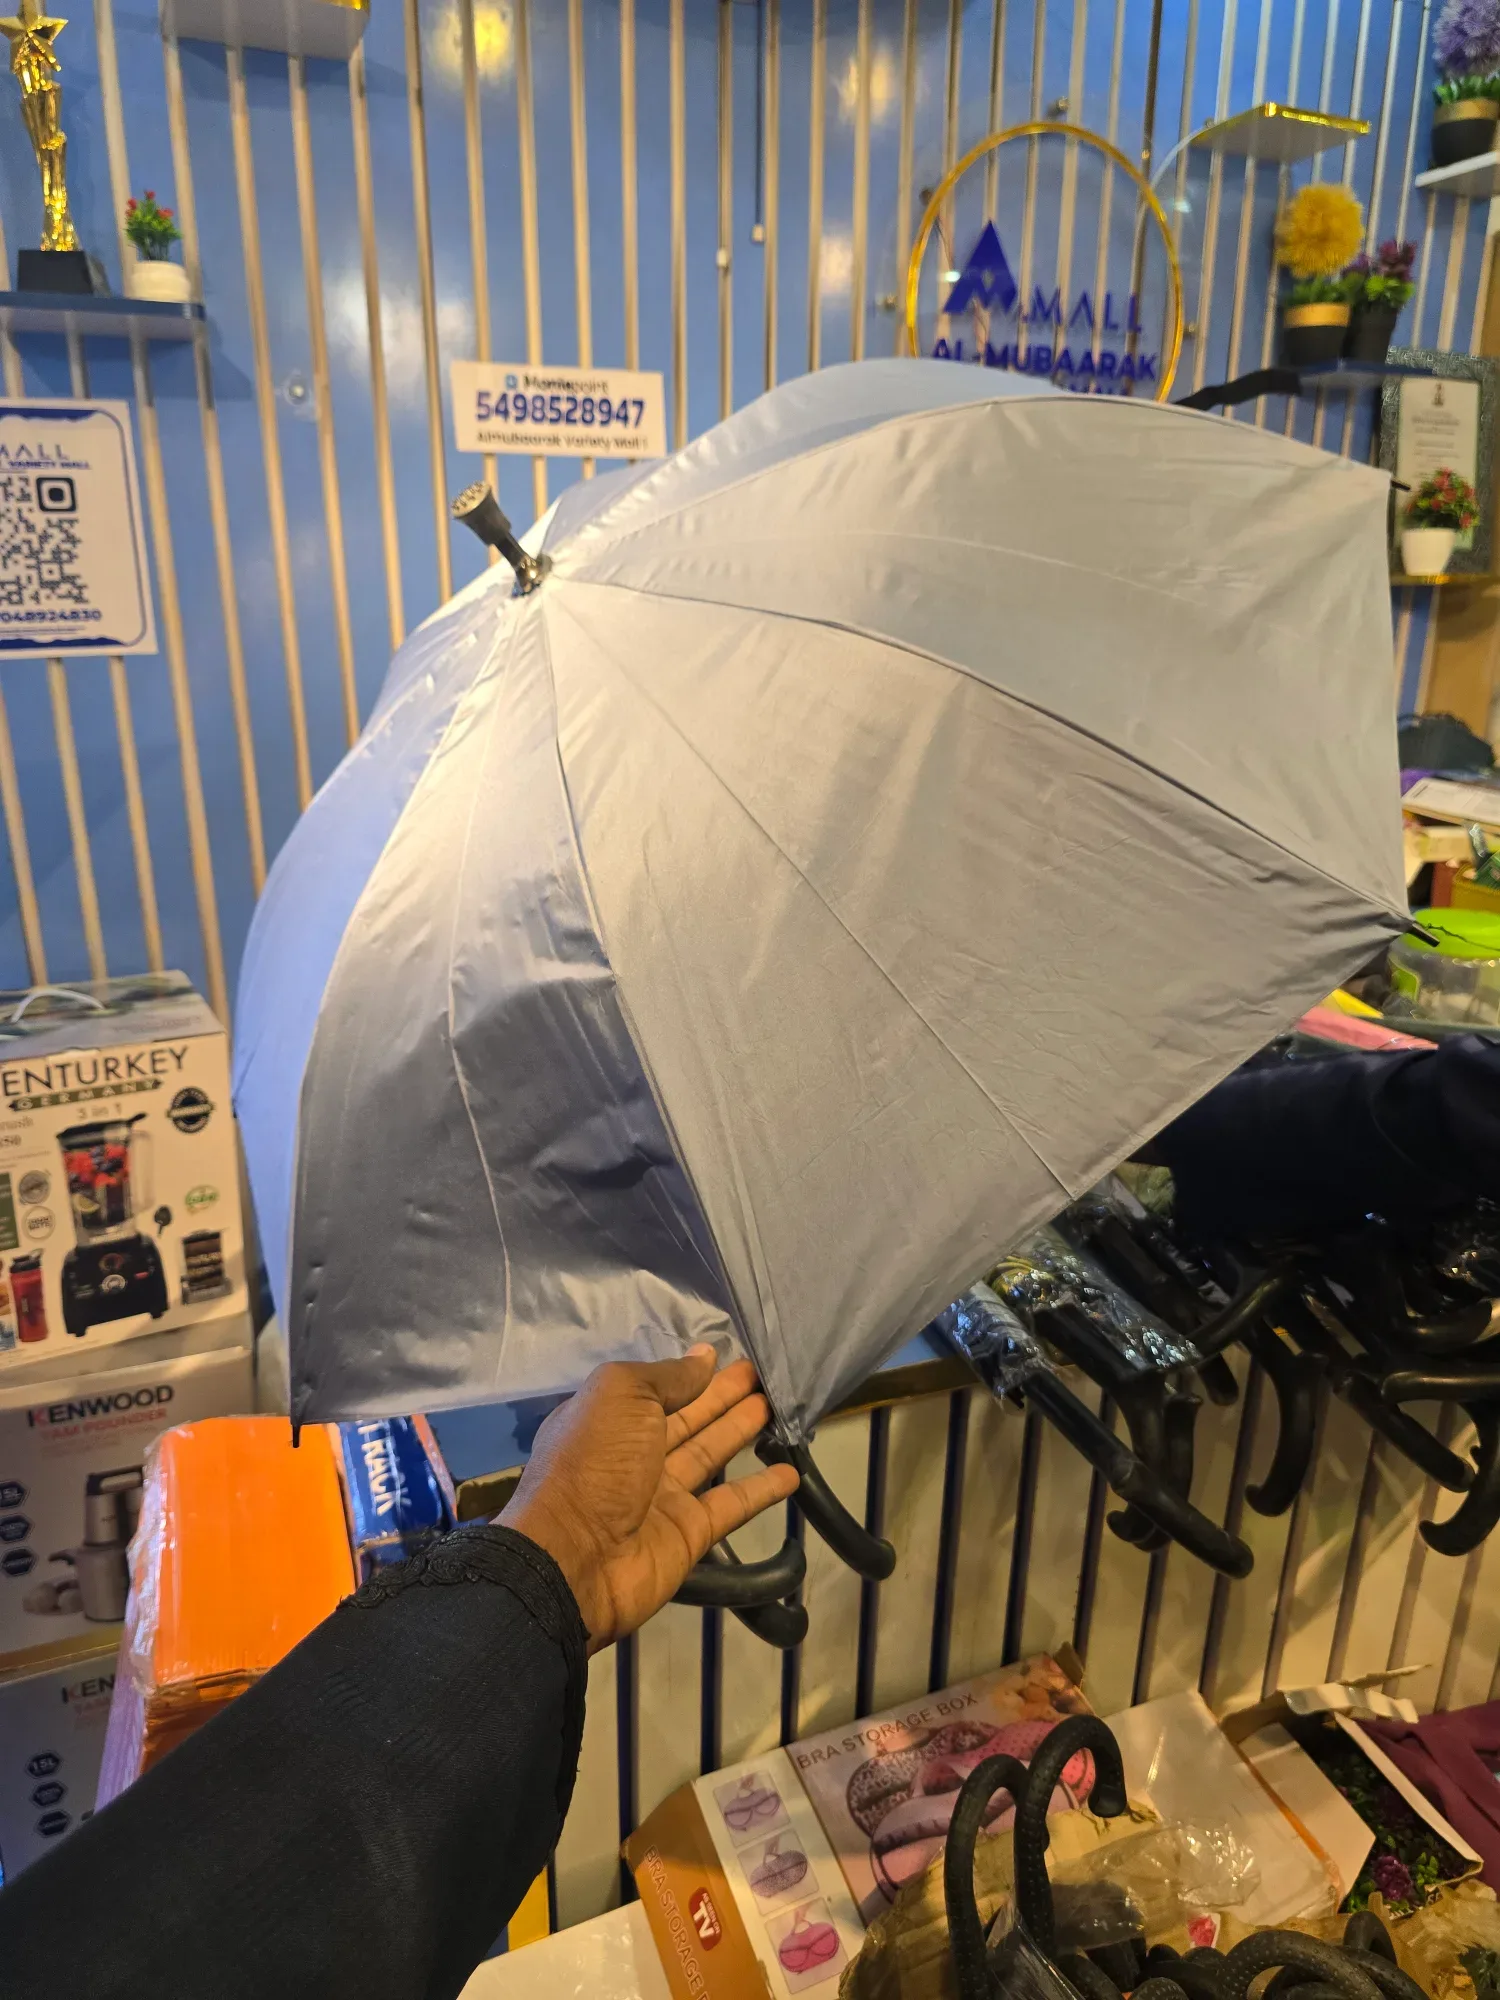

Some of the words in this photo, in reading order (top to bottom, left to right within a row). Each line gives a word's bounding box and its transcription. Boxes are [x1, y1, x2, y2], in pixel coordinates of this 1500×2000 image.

[476, 391, 645, 428] 5498528947
[0, 608, 102, 622] 048924830
[2, 1046, 188, 1096] ENTURKEY
[18, 1080, 156, 1109] GERMANY
[27, 1385, 175, 1427] KENWOOD
[796, 1745, 841, 1769] BRA
[842, 1708, 934, 1752] STORAGE
[936, 1693, 978, 1716] BOX
[644, 1845, 668, 1893] BRA
[660, 1888, 704, 1995] STORAGE
[693, 1900, 715, 1938] TV
[707, 1902, 718, 1922] SEEN
